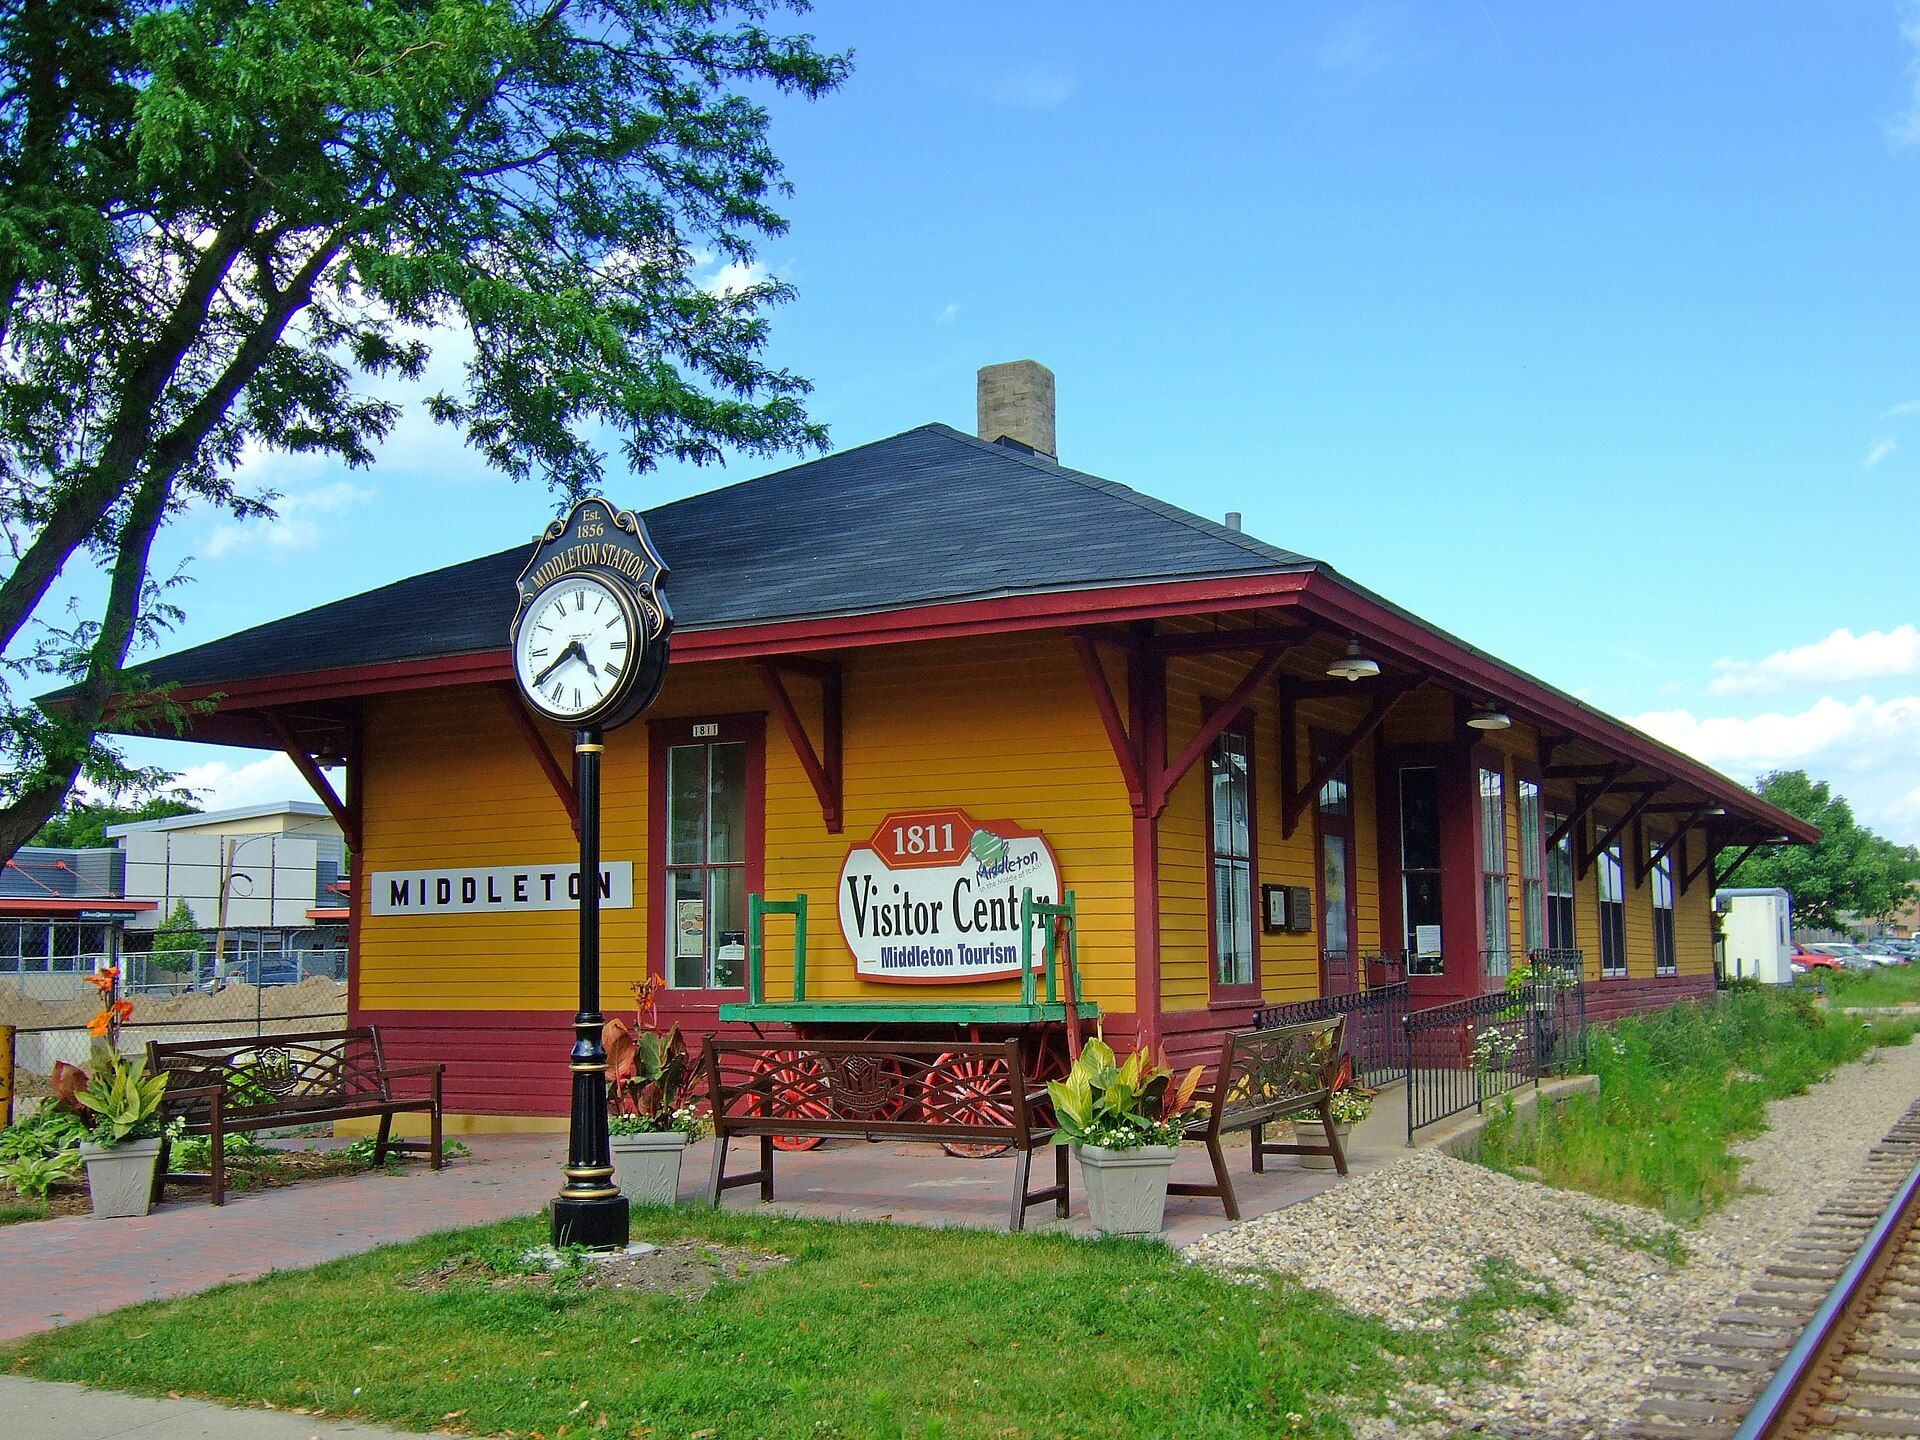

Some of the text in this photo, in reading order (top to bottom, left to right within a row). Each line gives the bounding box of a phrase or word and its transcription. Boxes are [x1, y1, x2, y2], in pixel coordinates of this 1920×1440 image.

[577, 523, 604, 539] 1856
[582, 509, 601, 521] Est.
[531, 543, 648, 588] MIDDLETON STATION
[694, 724, 717, 736] 1811
[893, 823, 955, 855] 1811
[976, 850, 1039, 887] Middleton
[390, 871, 611, 907] MIDDLETON
[847, 875, 1050, 938] Visitor Centr
[881, 942, 1017, 969] Middleton Tourism
